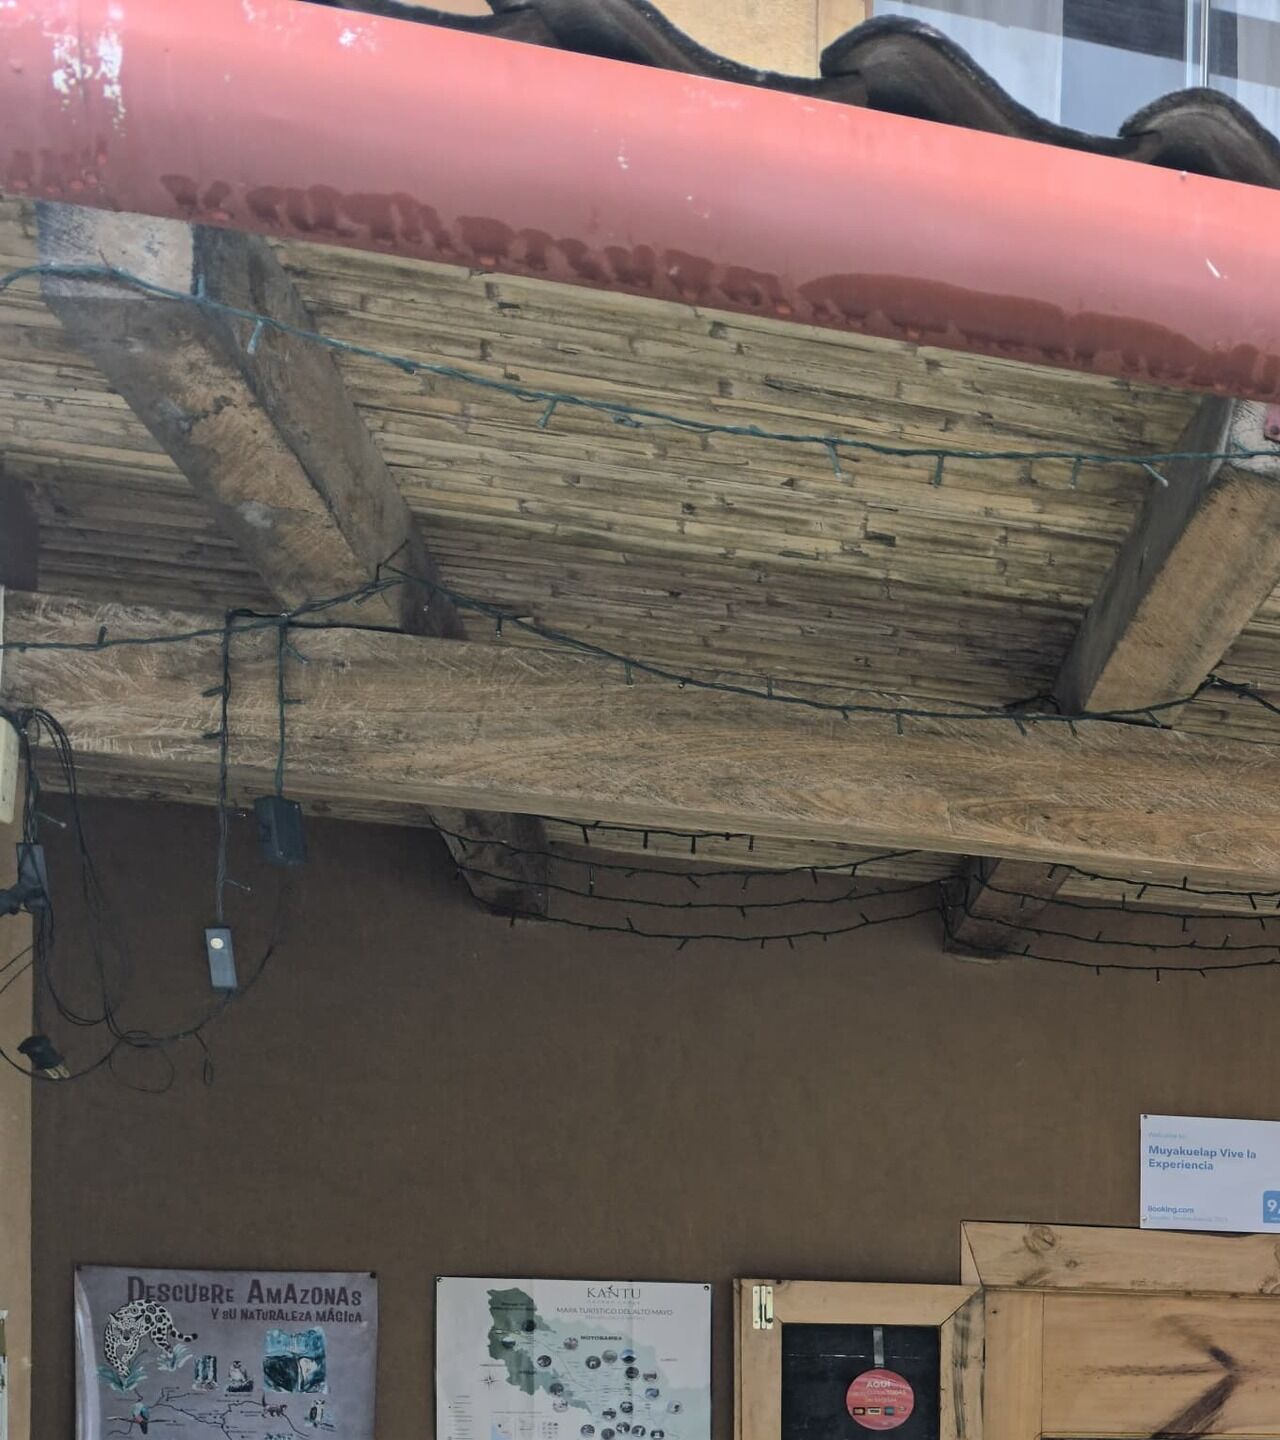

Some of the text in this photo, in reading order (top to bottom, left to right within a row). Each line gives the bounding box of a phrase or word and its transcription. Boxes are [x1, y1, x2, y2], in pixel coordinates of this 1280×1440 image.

[1148, 1145, 1257, 1159] Muyakuelap Vive la
[1148, 1159, 1214, 1171] Experiencia
[1148, 1205, 1194, 1214] Booking.com
[587, 1286, 641, 1299] KANTU
